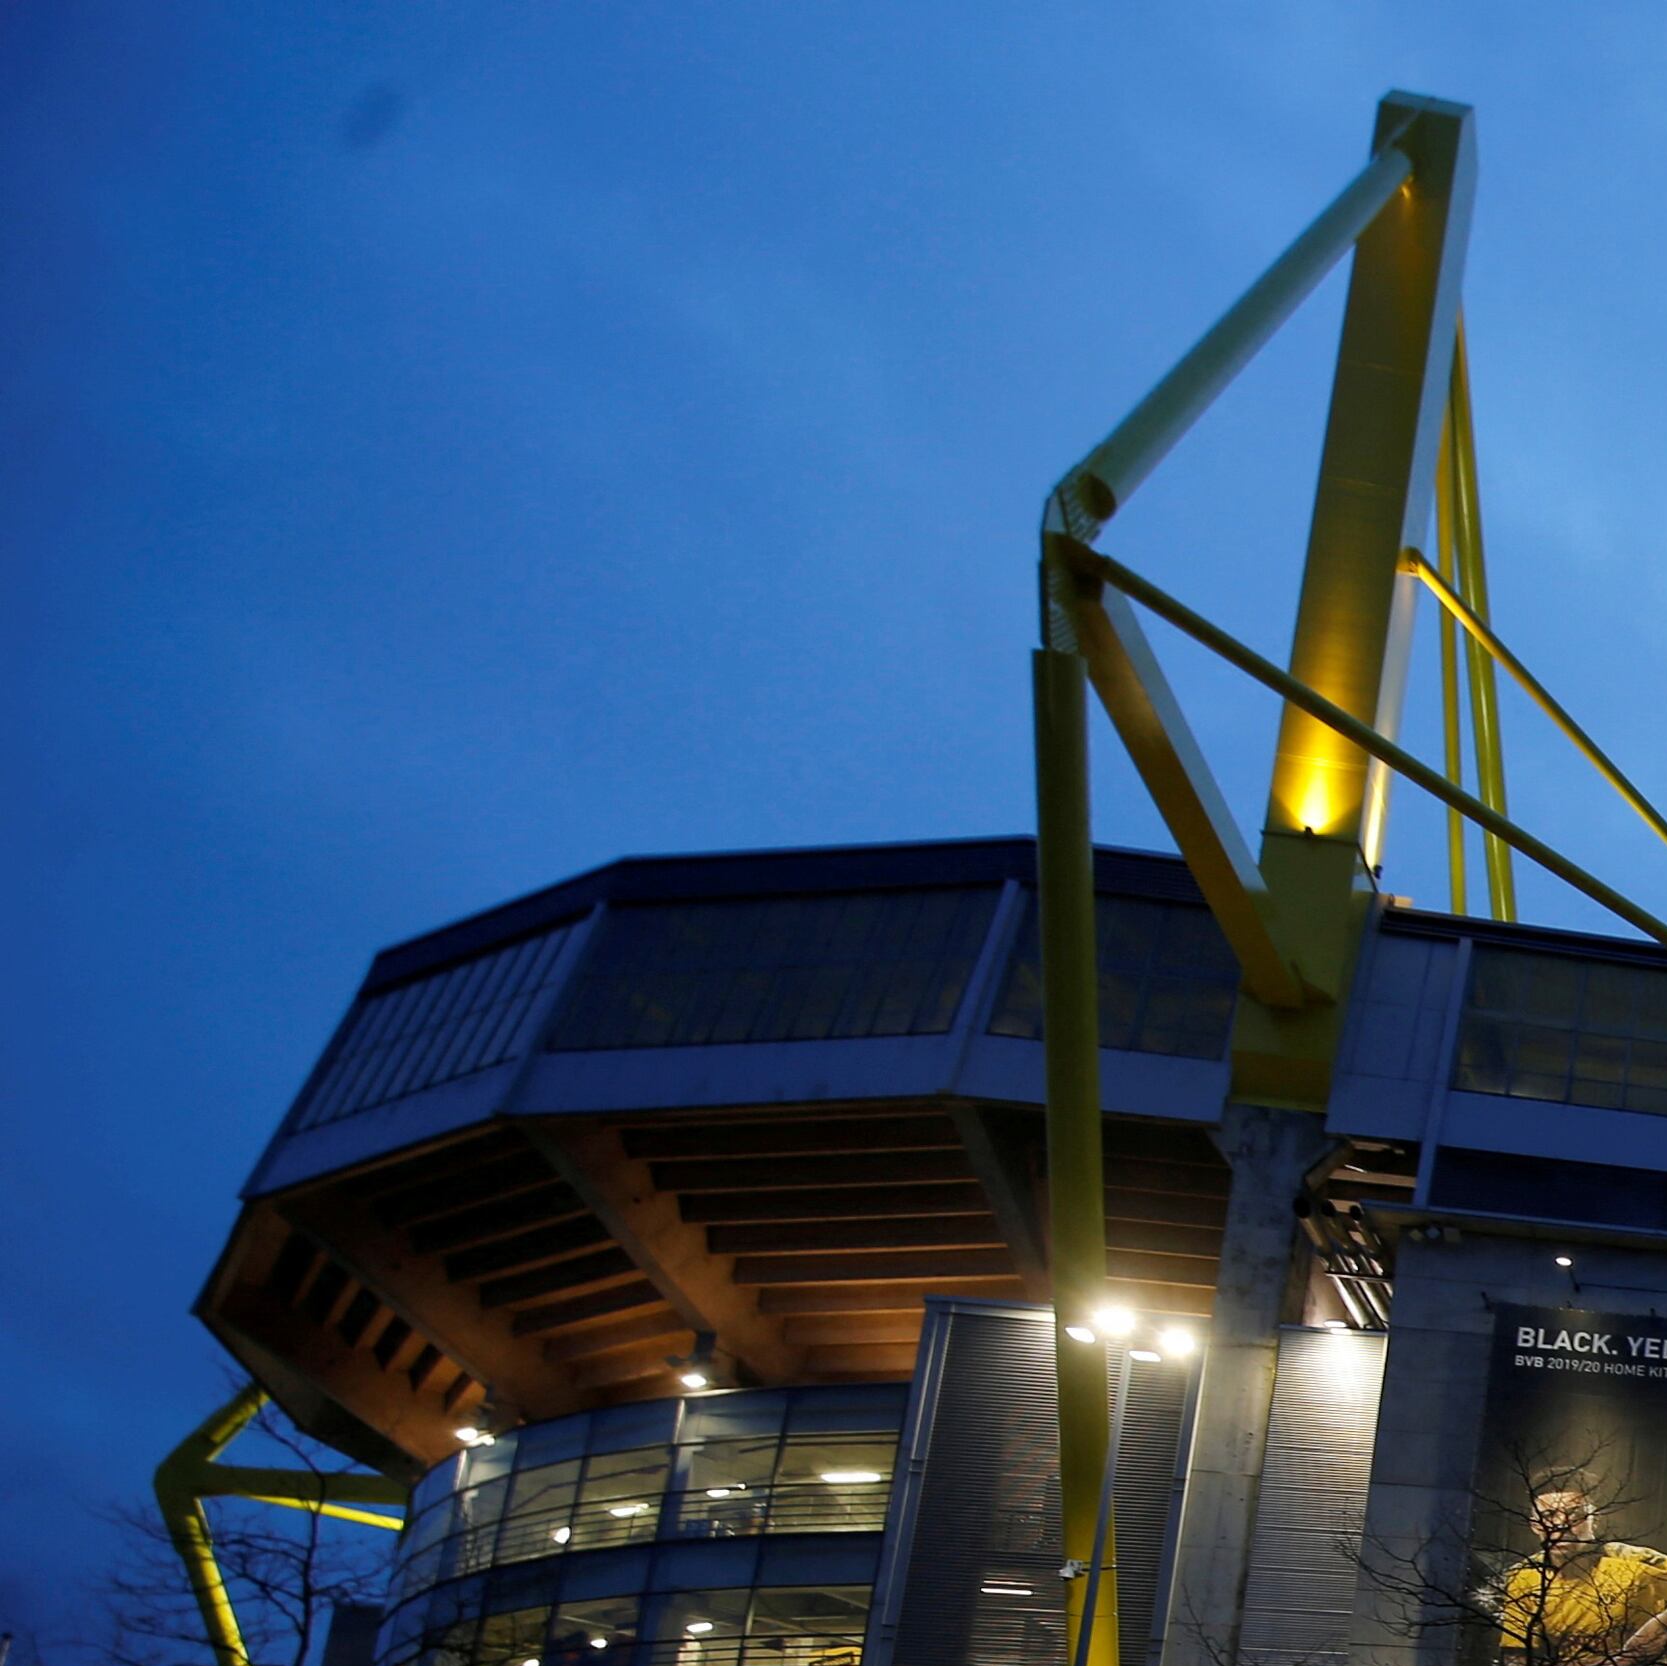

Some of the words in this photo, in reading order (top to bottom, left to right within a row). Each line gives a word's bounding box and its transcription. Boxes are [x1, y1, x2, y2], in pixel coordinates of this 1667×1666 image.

[1516, 1326, 1619, 1356] BLACK.
[1514, 1355, 1544, 1368] BVB
[1546, 1357, 1600, 1374] 2019/20
[1604, 1362, 1646, 1377] HOME
